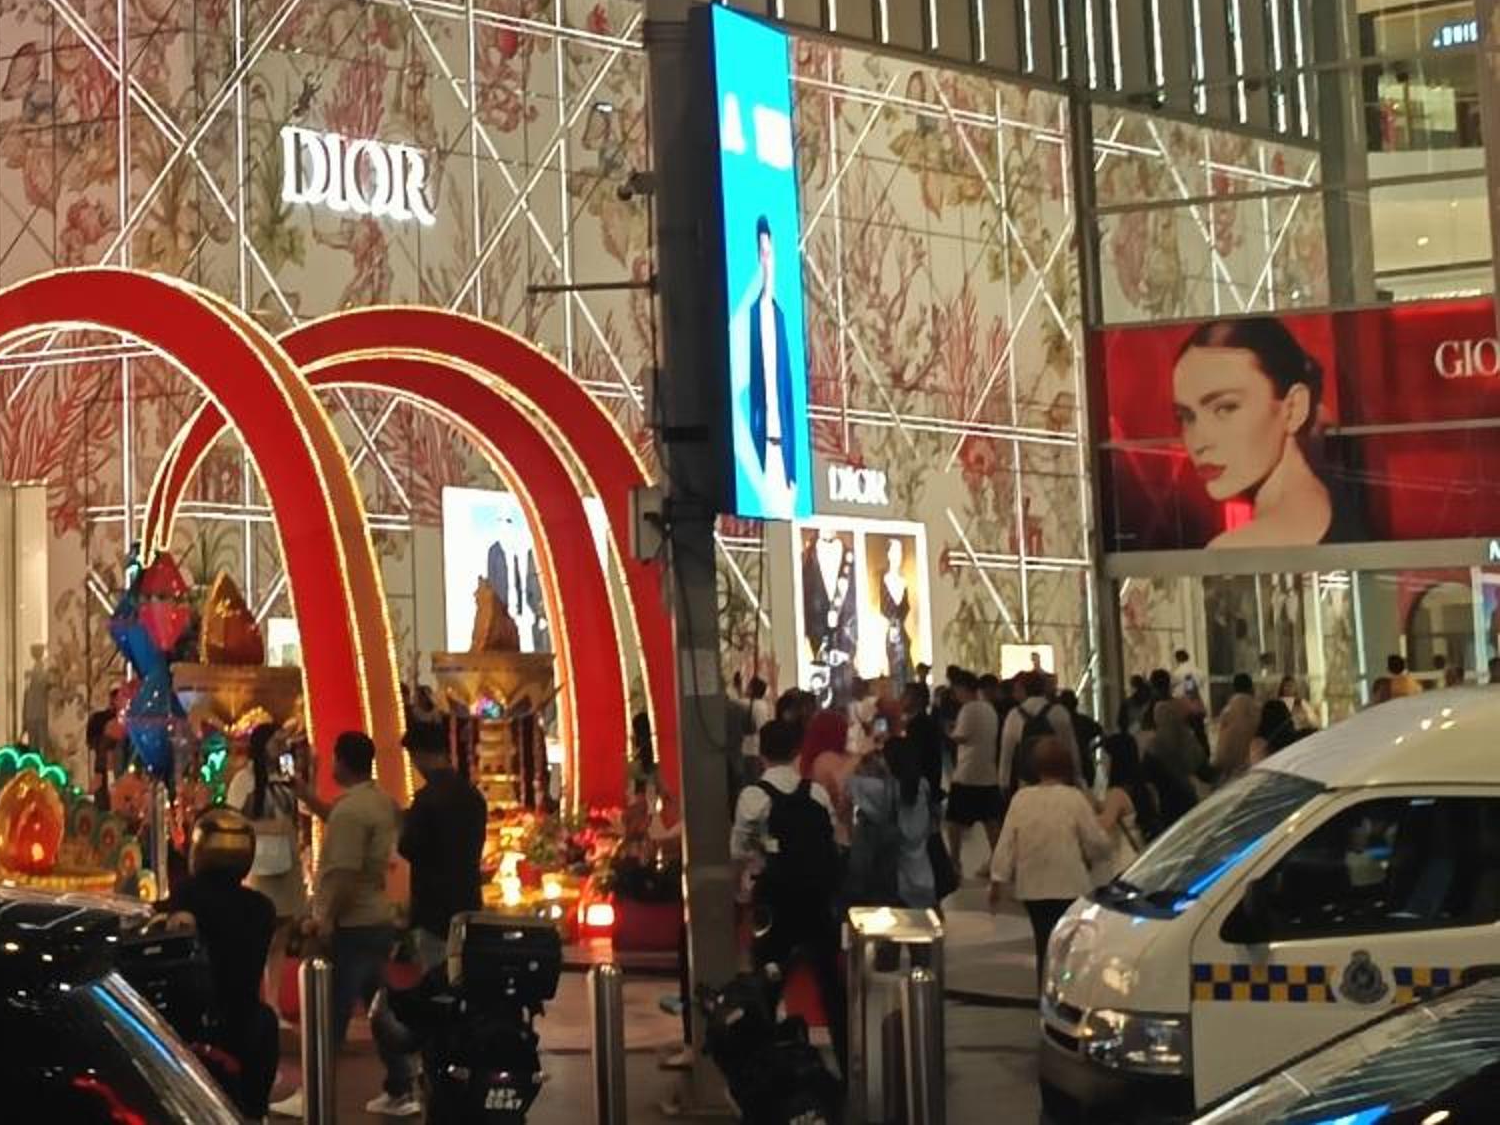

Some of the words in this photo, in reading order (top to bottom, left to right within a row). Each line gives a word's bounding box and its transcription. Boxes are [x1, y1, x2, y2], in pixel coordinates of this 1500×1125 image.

[280, 125, 437, 226] DIOR
[1434, 337, 1500, 379] GIO
[828, 463, 889, 505] DIOR
